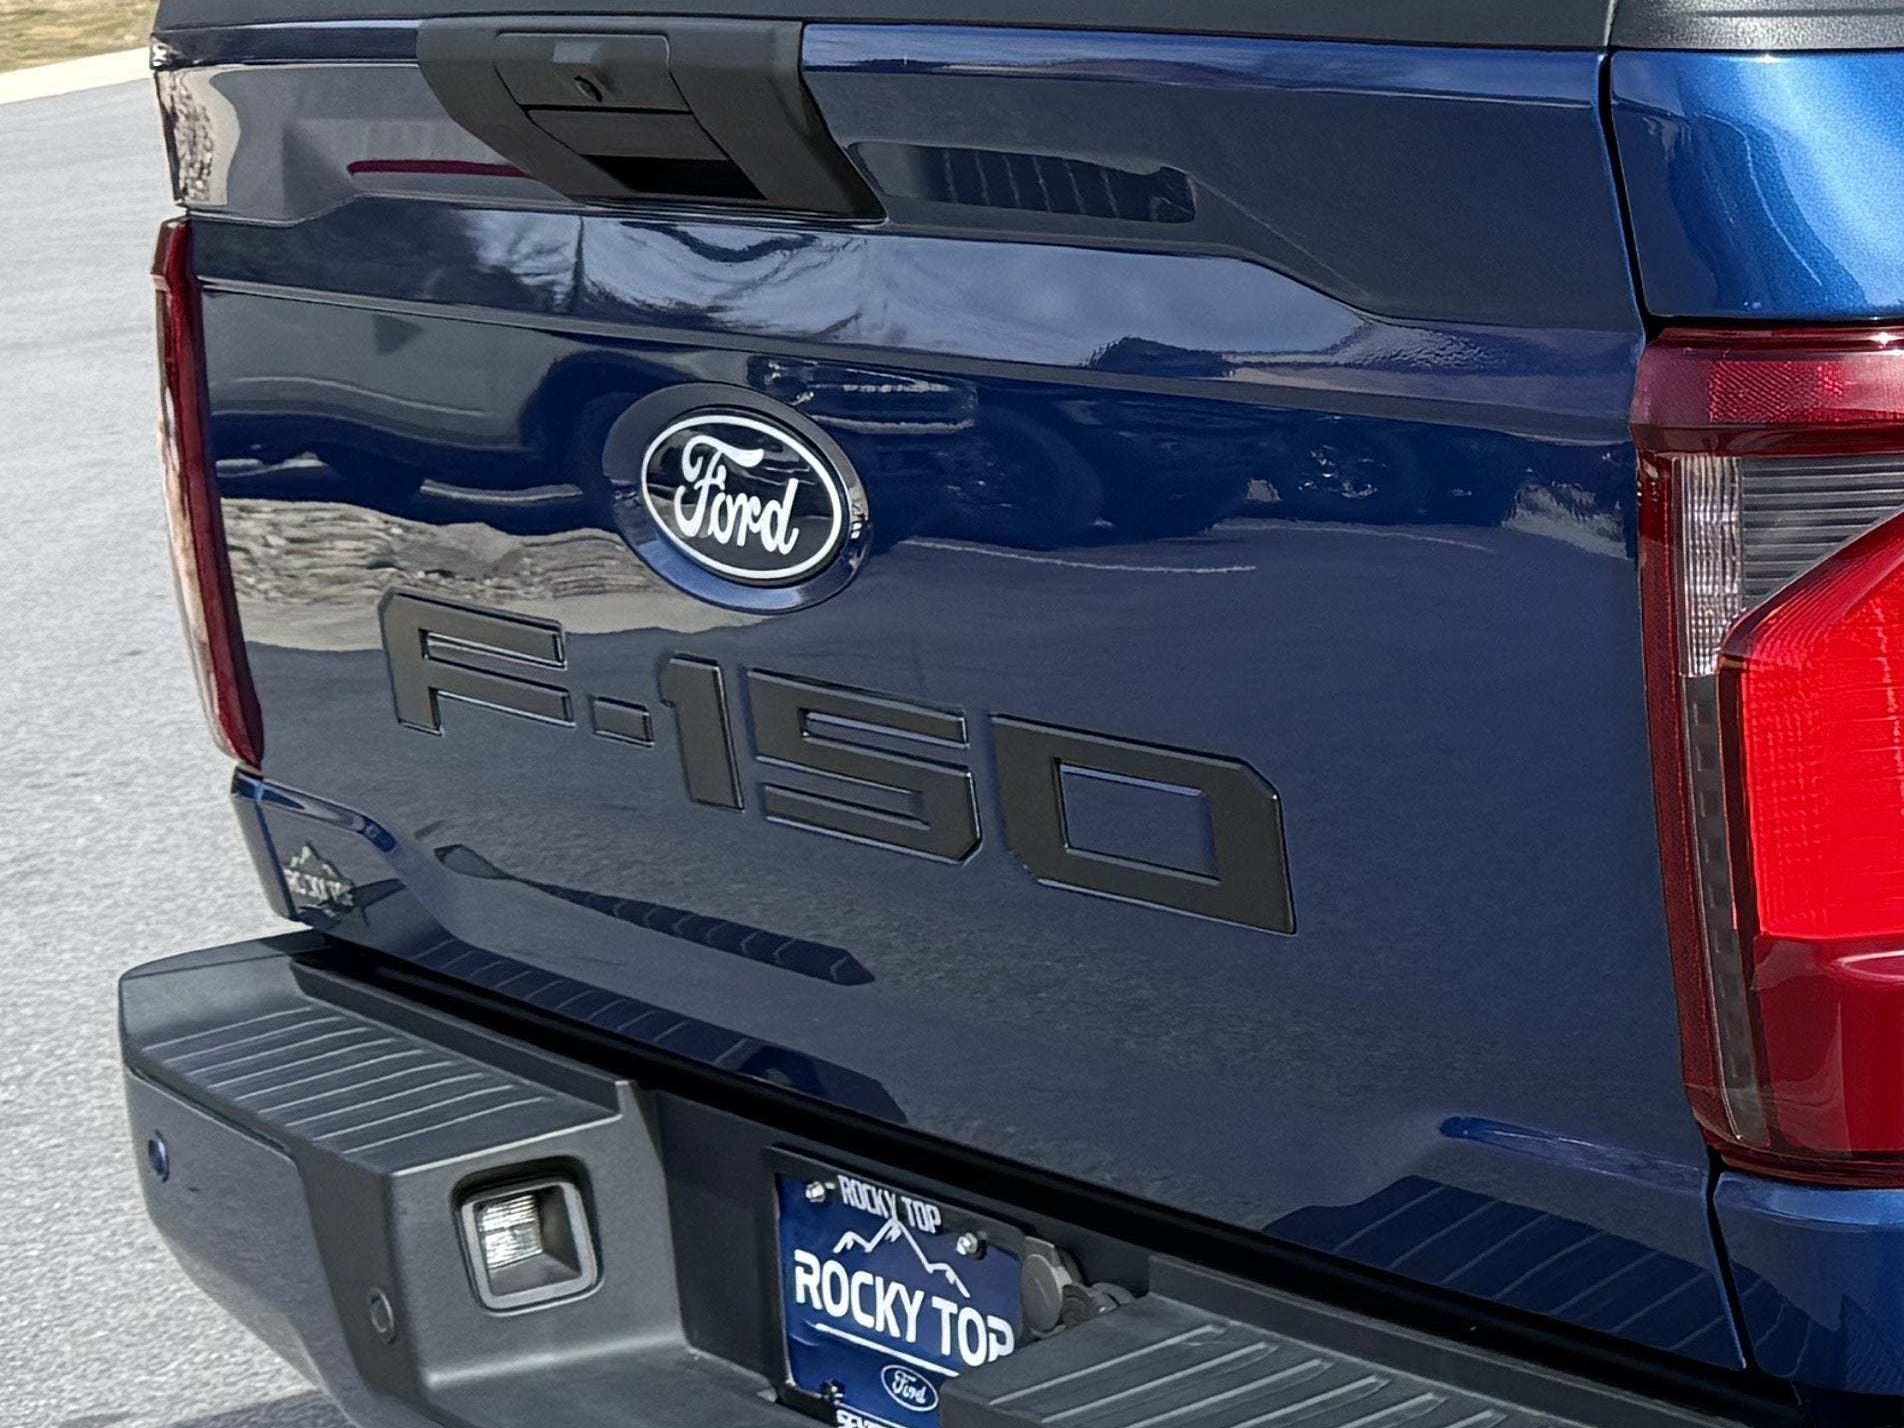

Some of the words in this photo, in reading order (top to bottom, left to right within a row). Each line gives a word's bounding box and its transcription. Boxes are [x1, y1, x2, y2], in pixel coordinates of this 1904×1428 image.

[674, 435, 801, 557] Ford
[381, 588, 1297, 935] F-150
[838, 1174, 896, 1217] ROCKY
[901, 1197, 942, 1234] TOP
[794, 1249, 925, 1343] ROCKY
[931, 1296, 1015, 1367] TOP
